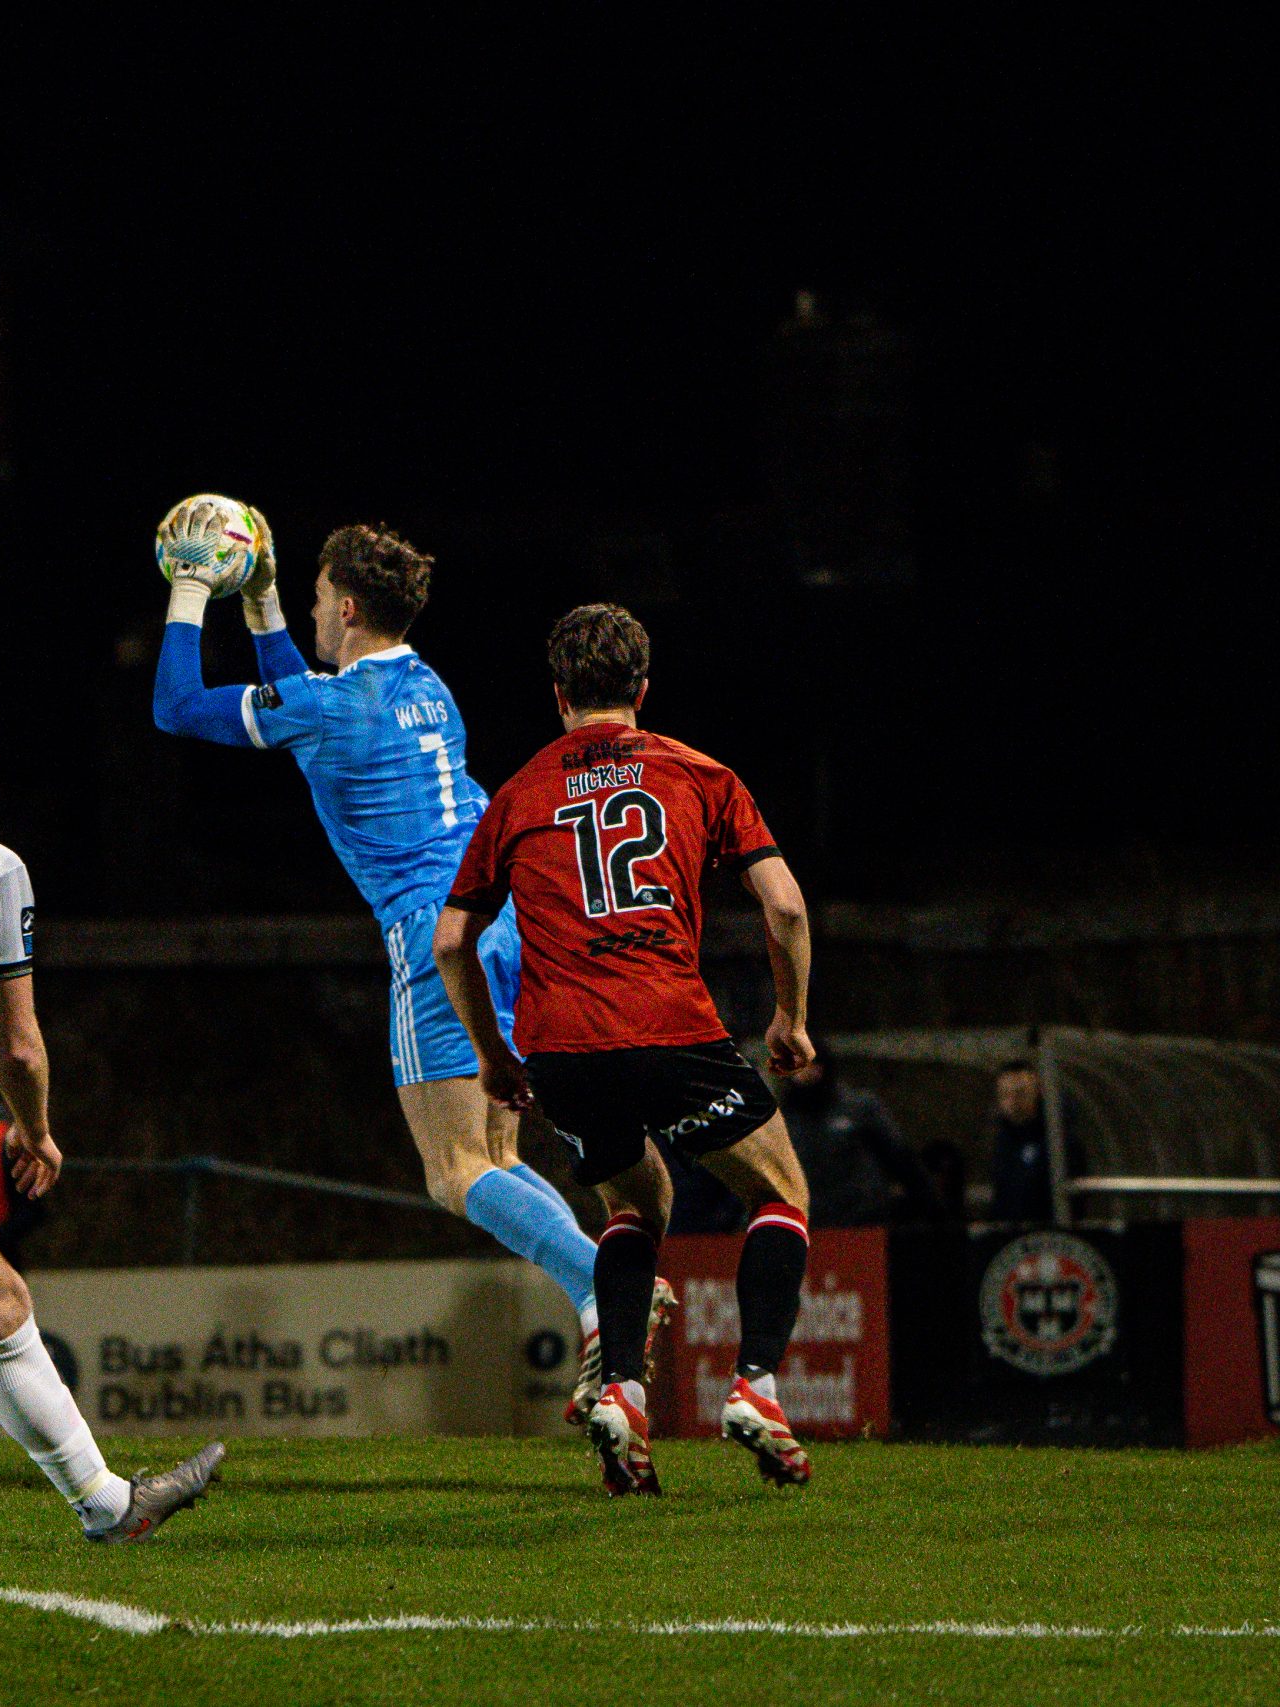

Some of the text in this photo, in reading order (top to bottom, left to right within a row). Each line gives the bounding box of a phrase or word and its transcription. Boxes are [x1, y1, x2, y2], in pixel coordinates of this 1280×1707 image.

[566, 762, 643, 798] HICKEY
[554, 788, 675, 918] 12
[99, 1335, 183, 1374] Bus
[319, 1326, 452, 1368] Cliath
[99, 1380, 349, 1422] Dublin Bus
